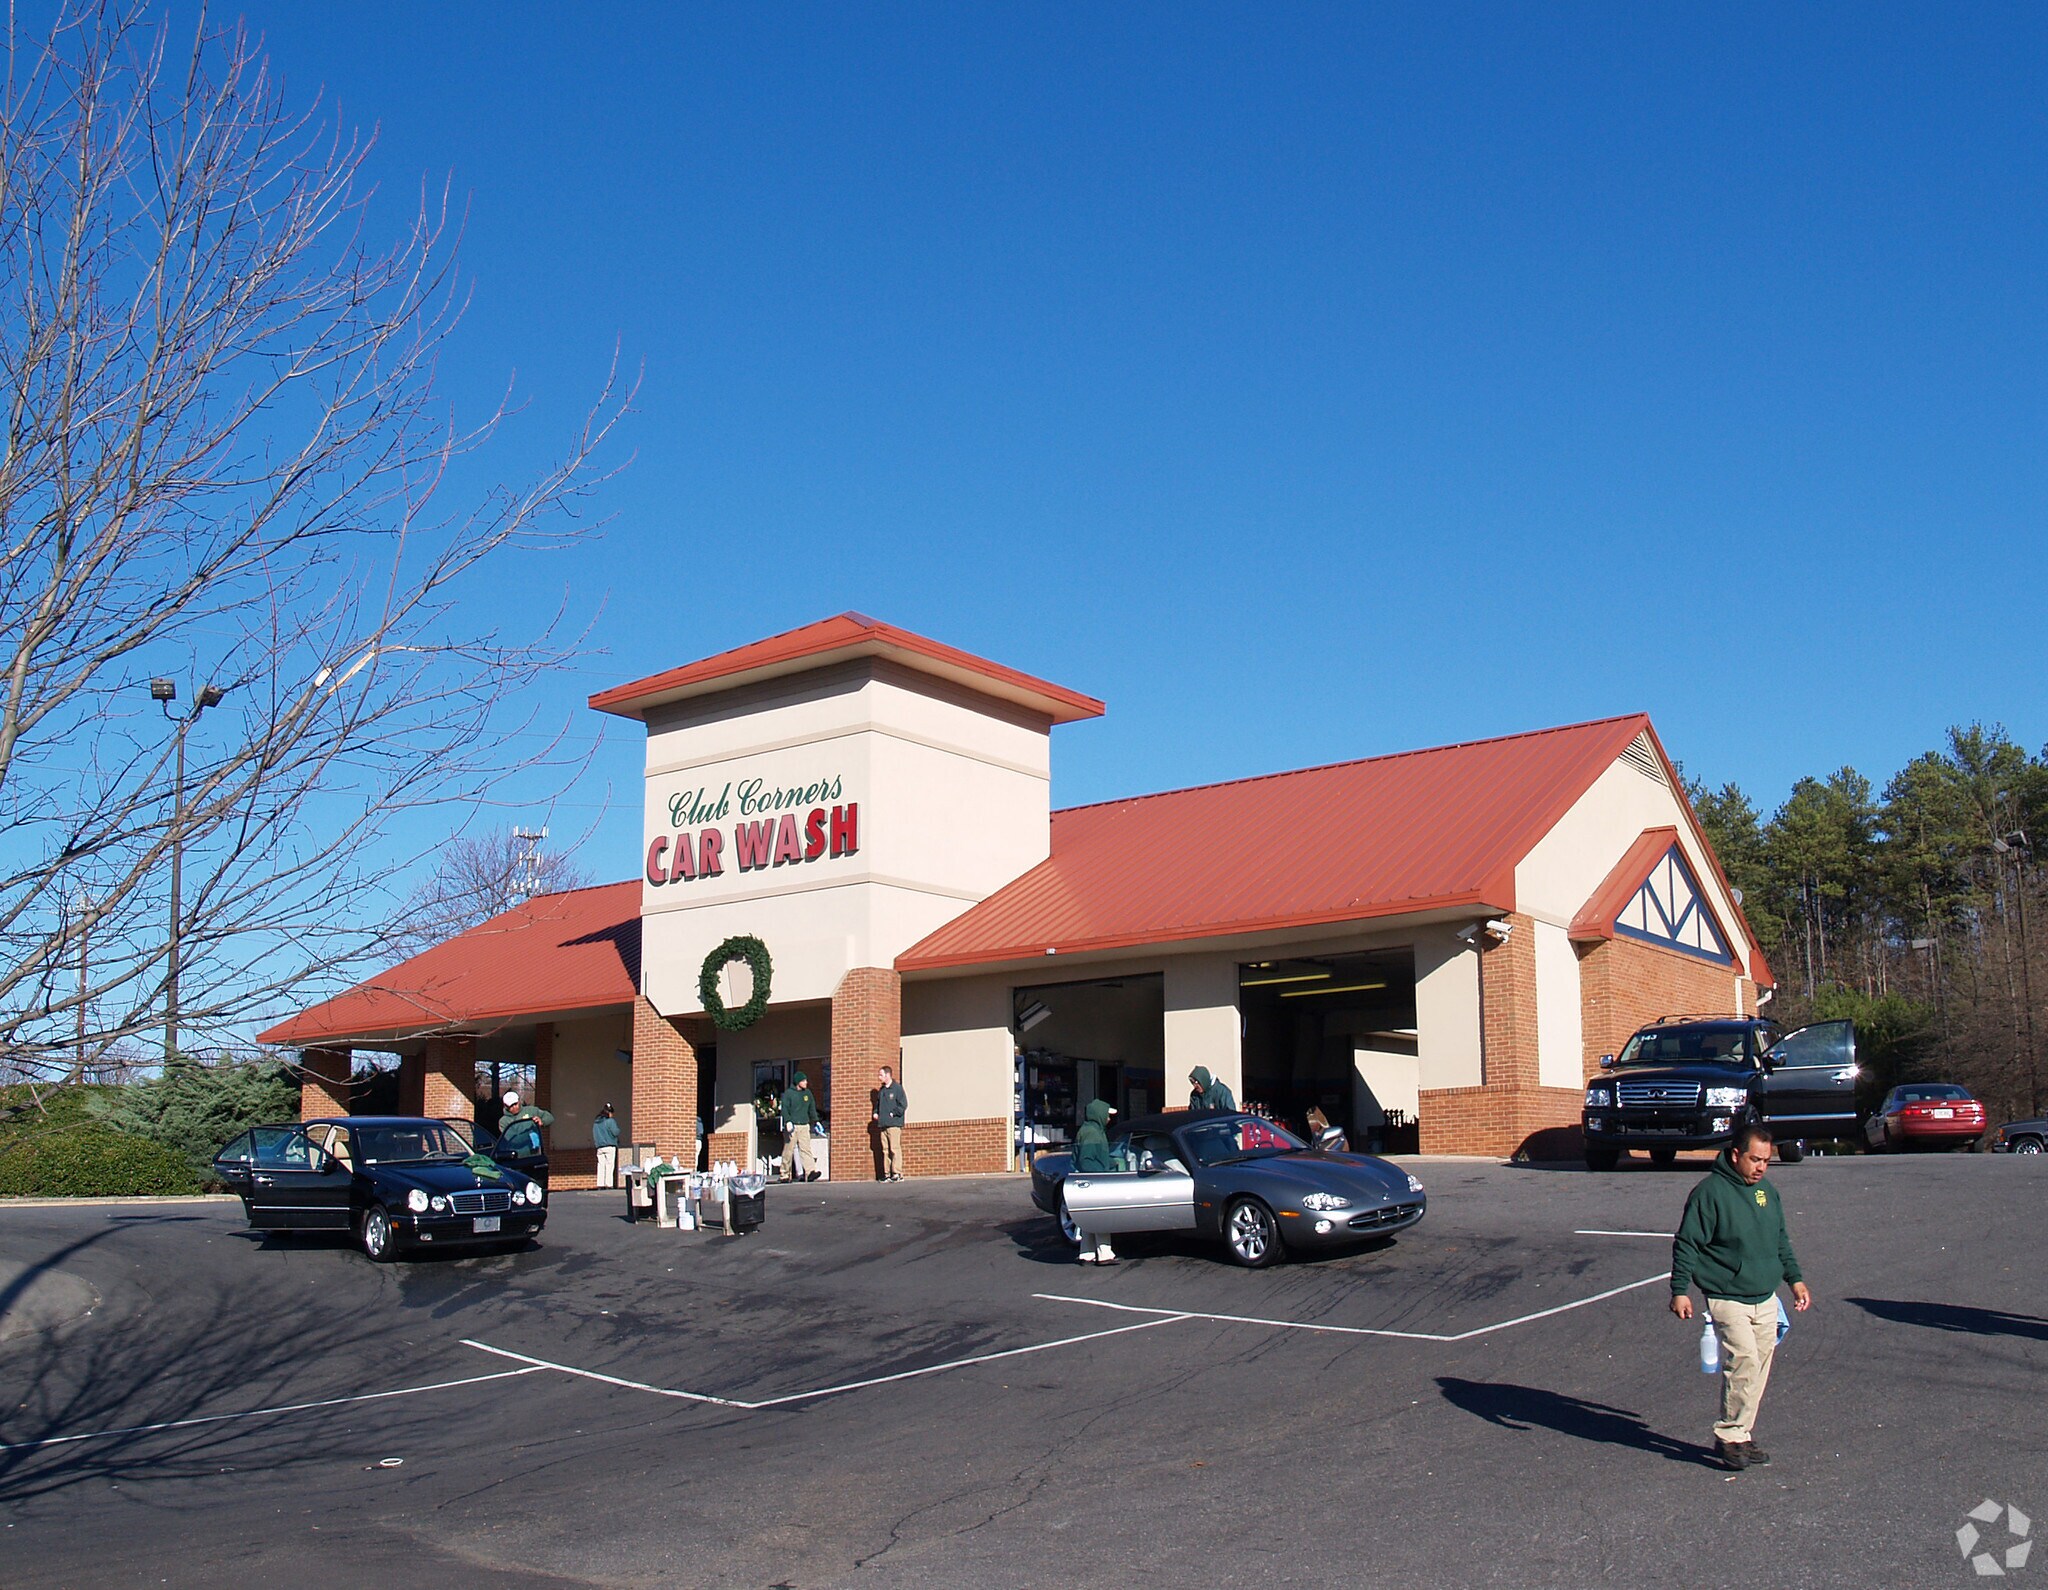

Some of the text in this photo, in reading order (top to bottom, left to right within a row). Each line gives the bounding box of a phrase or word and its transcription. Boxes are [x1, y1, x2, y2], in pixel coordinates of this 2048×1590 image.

[668, 774, 842, 827] Club Corners
[646, 802, 860, 888] CAR WASH
